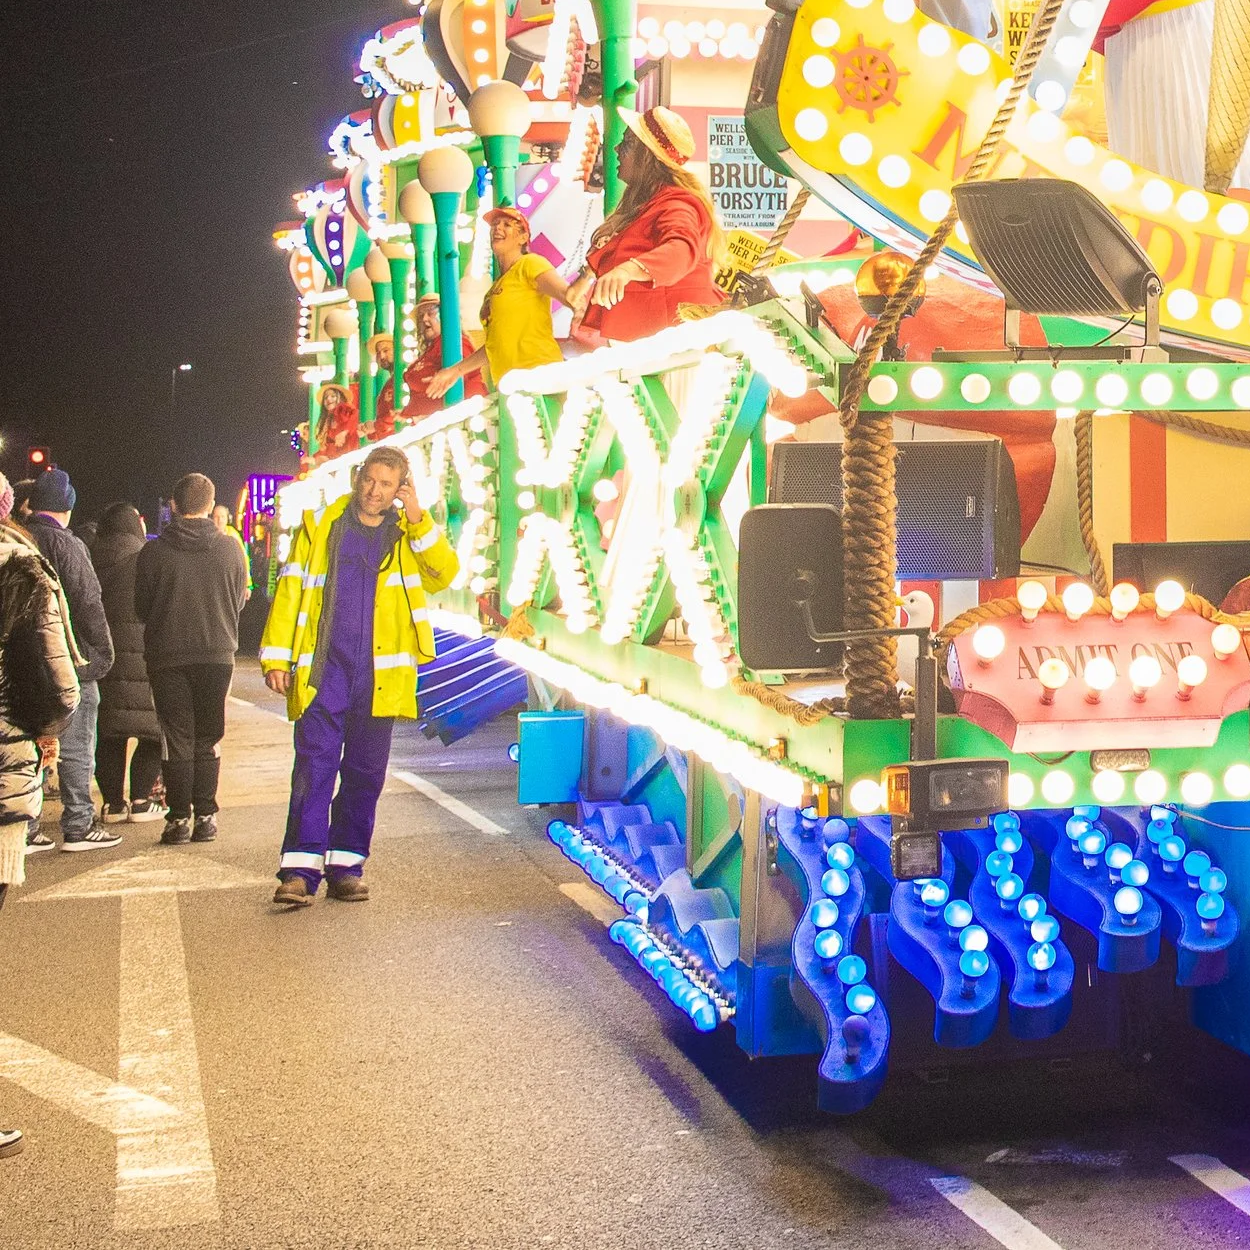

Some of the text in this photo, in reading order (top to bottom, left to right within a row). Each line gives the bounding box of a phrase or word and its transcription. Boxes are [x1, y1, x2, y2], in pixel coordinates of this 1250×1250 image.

[709, 134, 734, 146] PIER
[709, 162, 788, 189] BRUCE
[711, 191, 788, 211] FORSYTH
[728, 241, 750, 263] PIER
[737, 235, 765, 254] WELLS
